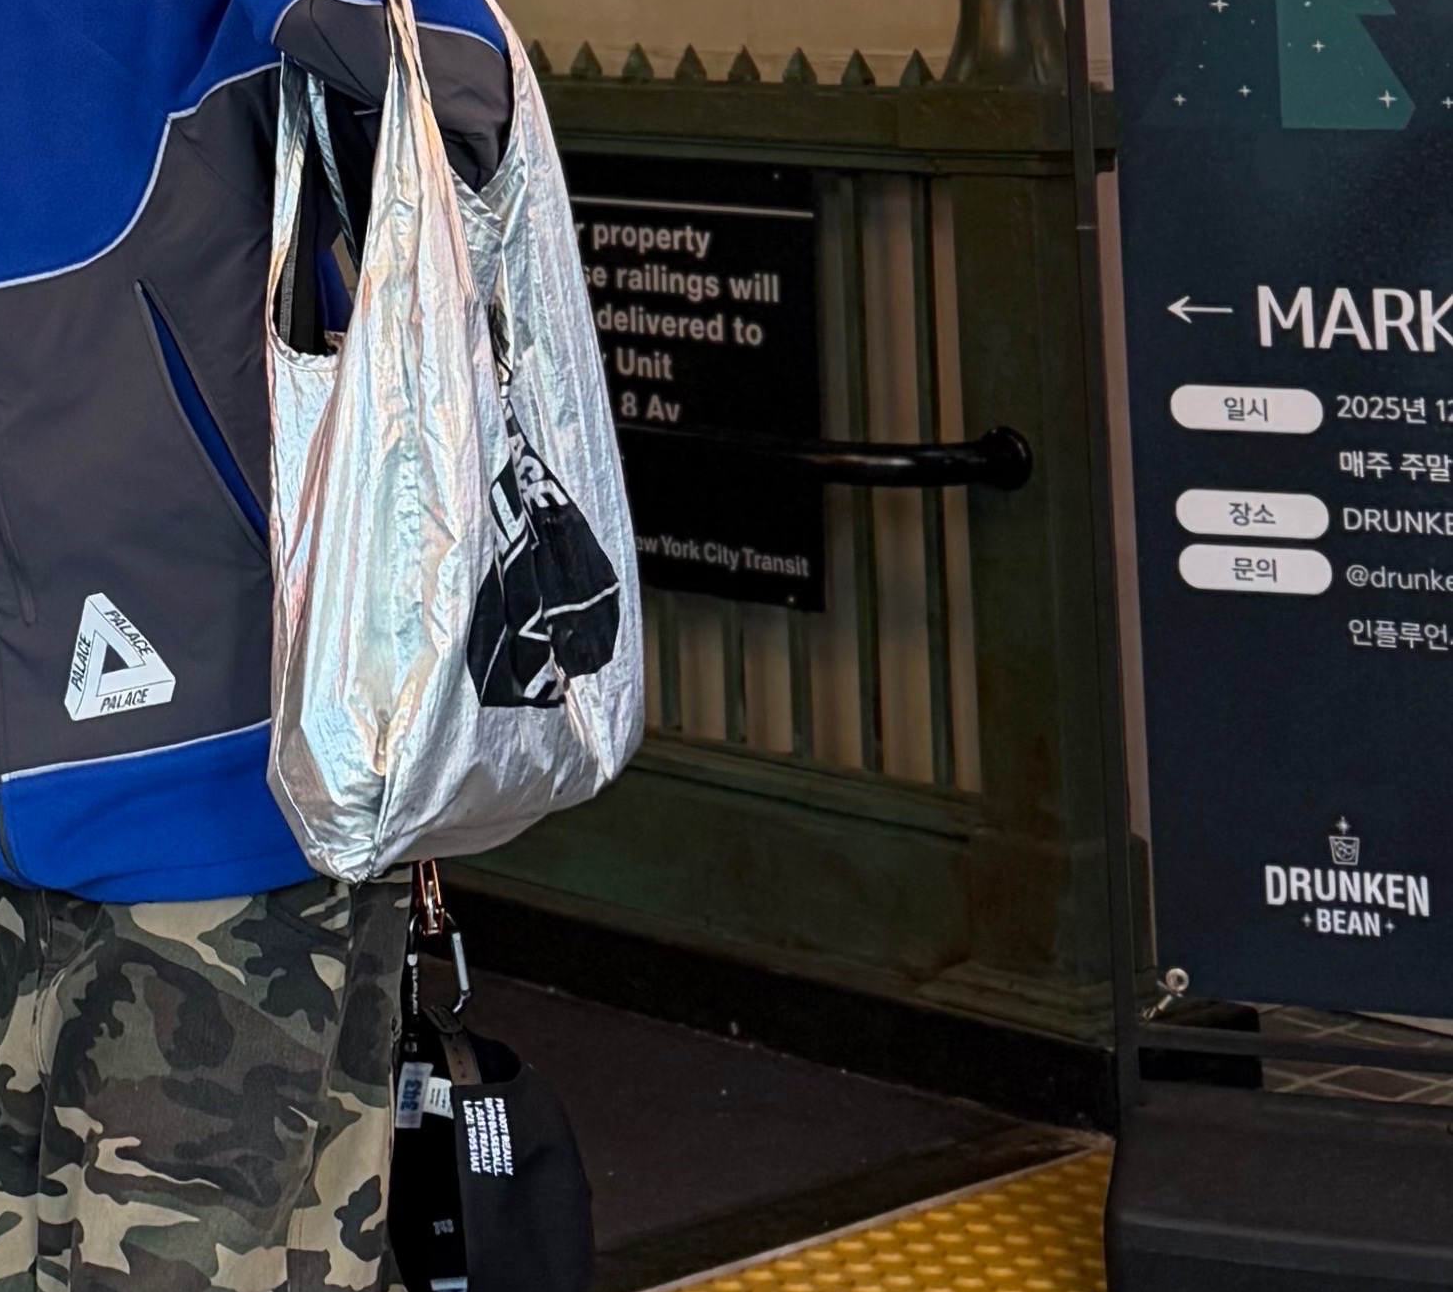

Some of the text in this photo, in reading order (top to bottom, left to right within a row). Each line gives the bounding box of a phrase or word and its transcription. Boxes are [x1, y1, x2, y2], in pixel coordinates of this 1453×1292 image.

[593, 222, 711, 258] property
[616, 263, 720, 303] railings
[729, 272, 781, 303] will
[597, 303, 764, 346] delivered to
[616, 347, 673, 382] Unit
[621, 393, 680, 423] 8 Av
[1223, 397, 1269, 423] 일시
[1336, 395, 1427, 424] 2025년
[1339, 450, 1453, 482] 매주 주말
[1229, 502, 1276, 526] 장소
[636, 534, 810, 577] ew York City Transit
[1232, 557, 1278, 583] 문의
[105, 610, 154, 656] PALACE
[1348, 618, 1453, 651] 인플루언
[70, 633, 91, 692] PALACE
[100, 688, 149, 713] PALACE
[1265, 865, 1429, 917] DRUNKEN
[1316, 908, 1380, 937] BEAN
[487, 1121, 503, 1177] BASEBALL
